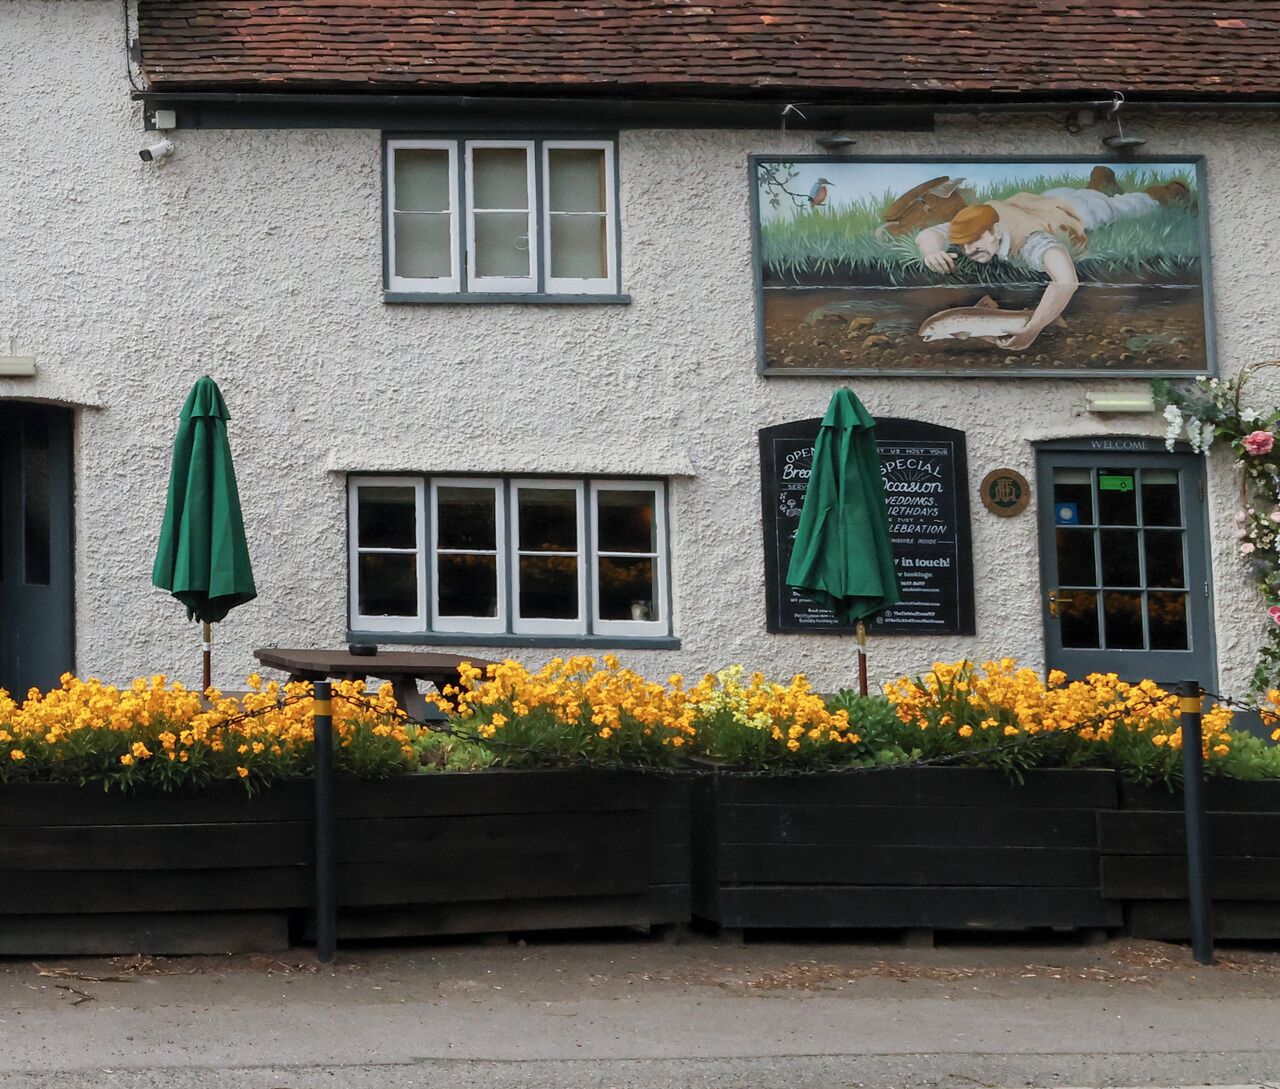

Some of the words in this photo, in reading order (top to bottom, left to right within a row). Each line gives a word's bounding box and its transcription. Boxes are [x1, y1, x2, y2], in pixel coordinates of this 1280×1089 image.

[1091, 440, 1147, 450] WELCOME
[782, 463, 812, 480] Brea
[887, 506, 939, 517] IRTHDAYS
[888, 524, 947, 534] LEBRATION
[901, 556, 914, 567] in
[915, 557, 951, 567] touch!
